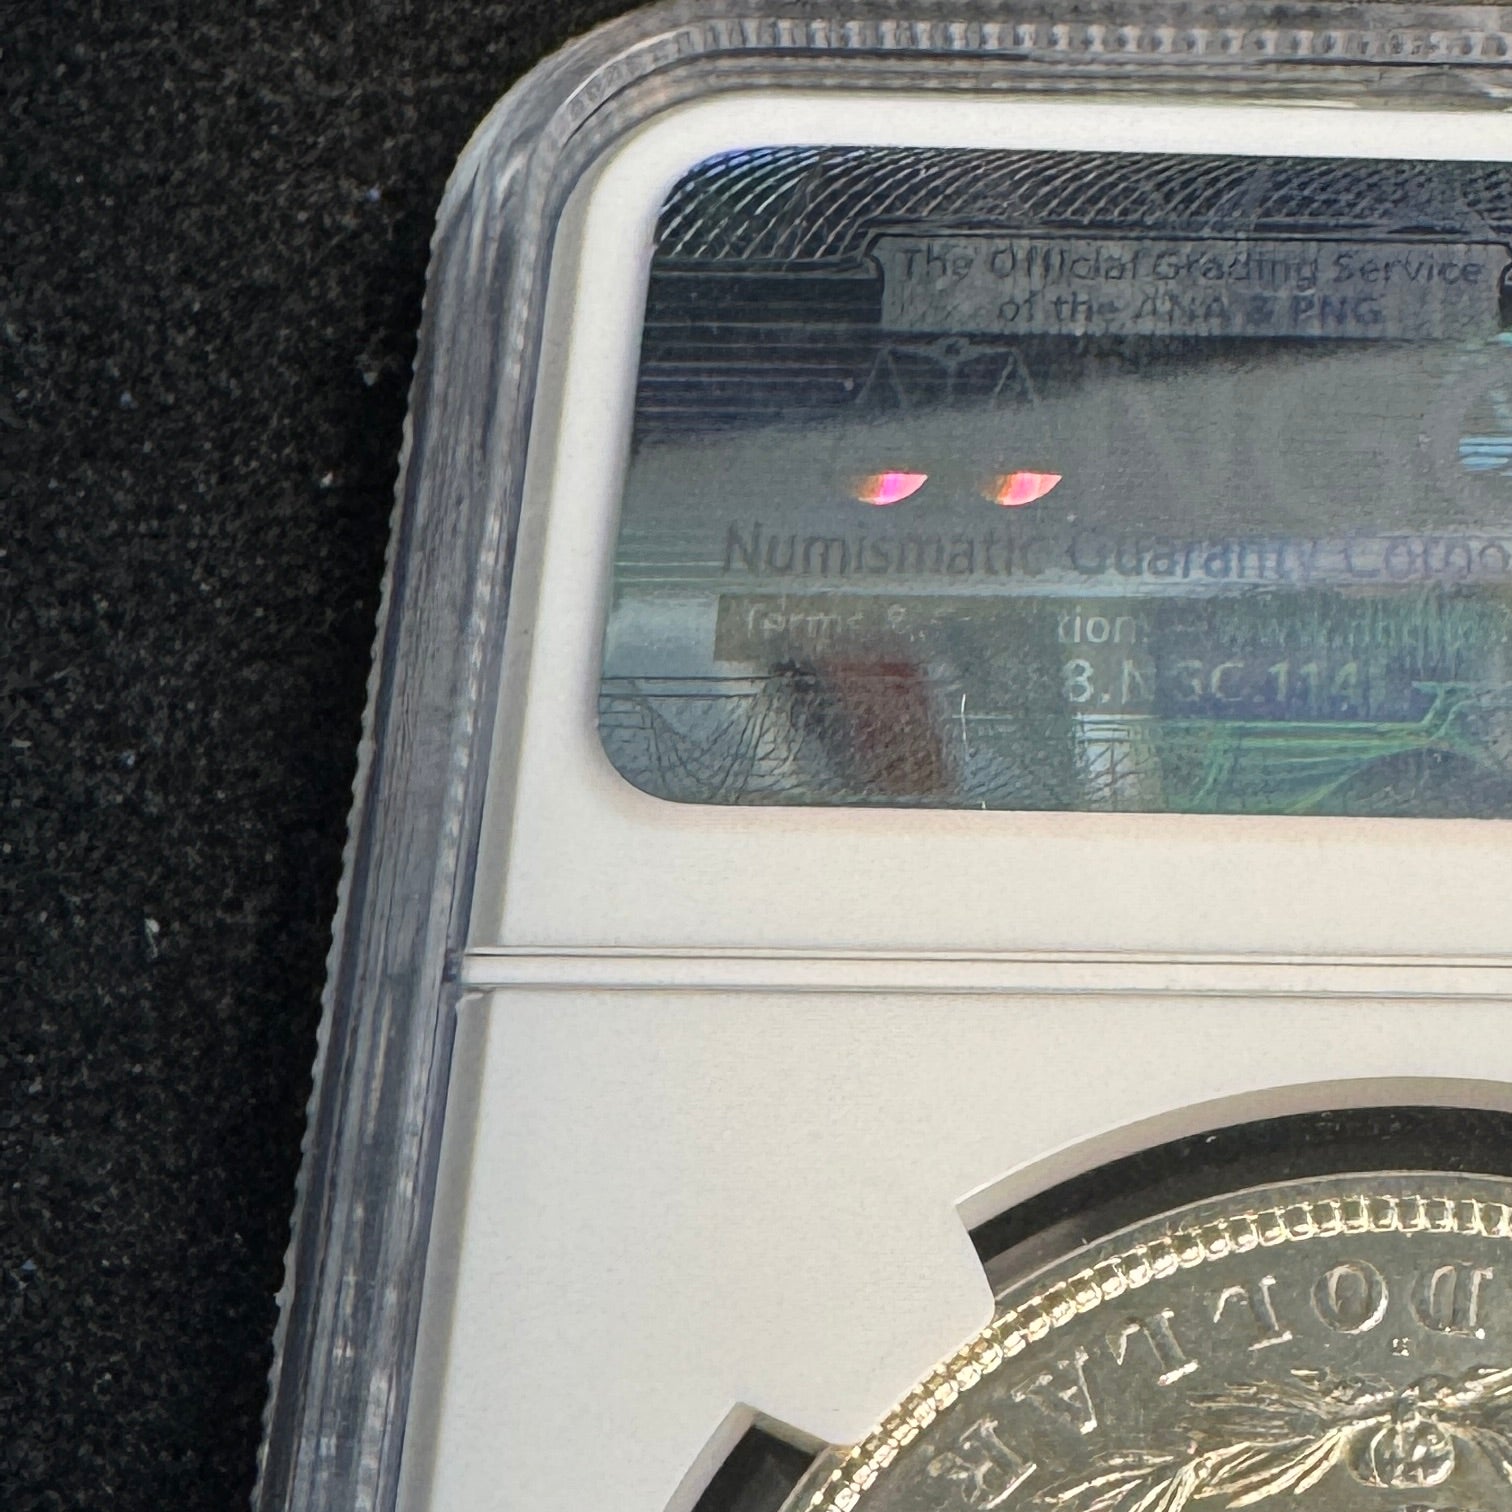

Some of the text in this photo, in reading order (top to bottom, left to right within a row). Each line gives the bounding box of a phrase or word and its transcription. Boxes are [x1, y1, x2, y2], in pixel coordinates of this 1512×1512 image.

[901, 246, 970, 280] The
[1152, 250, 1318, 290] Grading
[1333, 253, 1486, 287] Service
[998, 291, 1036, 323] of
[1053, 291, 1119, 322] the
[1131, 292, 1232, 323] ANA
[1293, 295, 1385, 325] PNG
[721, 520, 1047, 577] Numismatic
[926, 1258, 1495, 1510] DOLLAR
